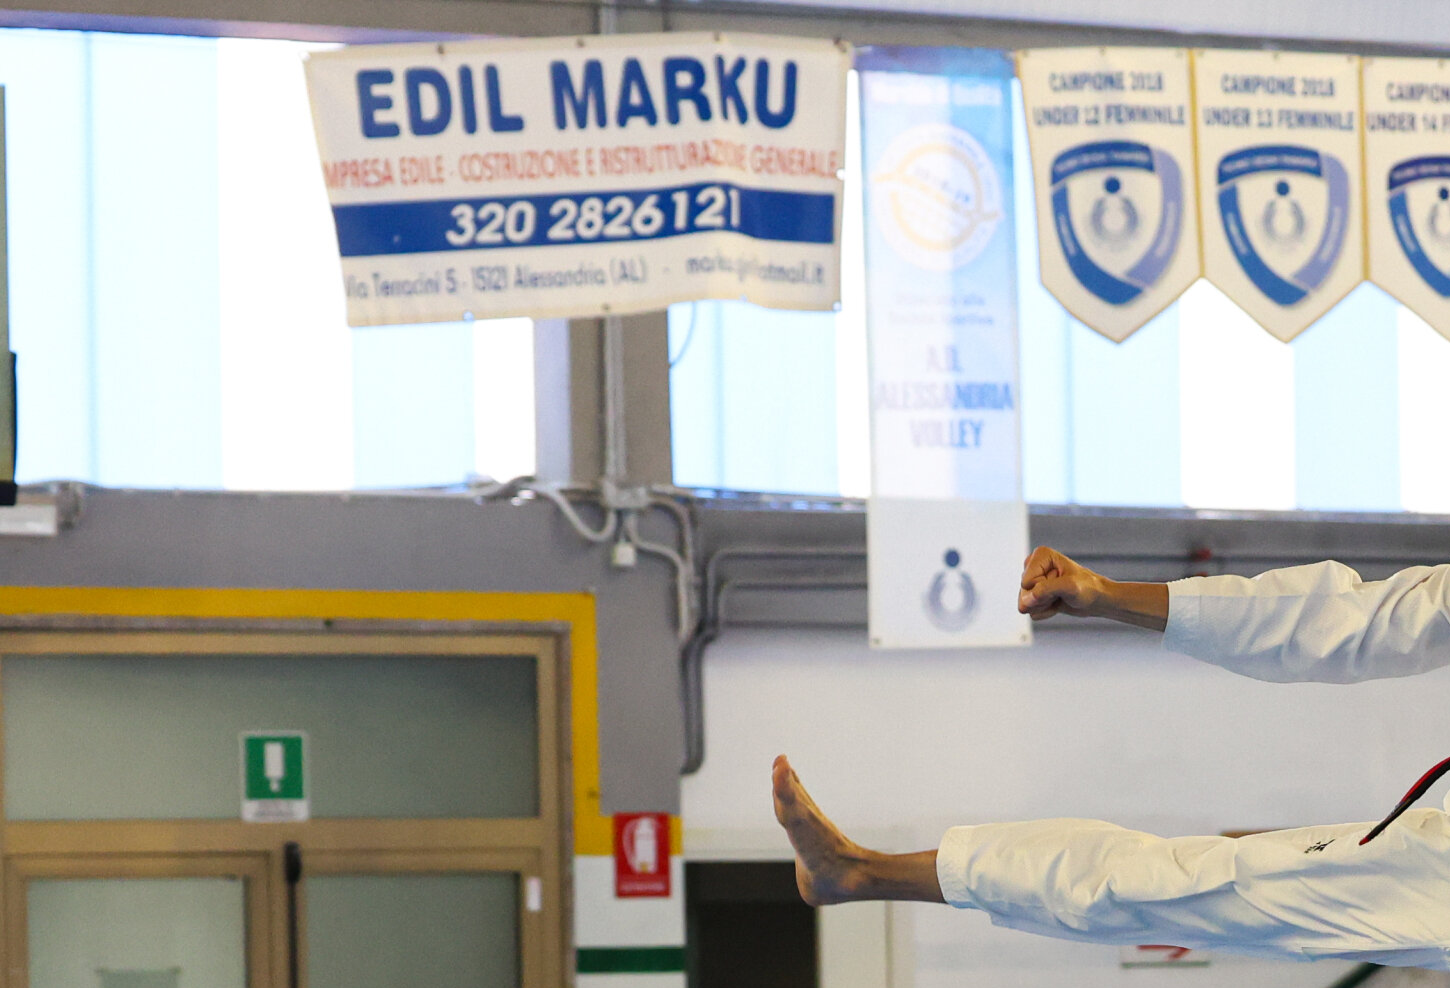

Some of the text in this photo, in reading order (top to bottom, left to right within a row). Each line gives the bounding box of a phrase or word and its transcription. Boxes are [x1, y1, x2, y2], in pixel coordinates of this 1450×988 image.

[1049, 71, 1125, 92] CAMPIONE
[1220, 74, 1296, 96] CAMPIONE
[356, 55, 798, 138] EDIL MARKU
[1032, 105, 1080, 126] UNDER
[1105, 103, 1185, 126] FEMMINILE
[1202, 107, 1251, 126] UNDER
[1278, 109, 1354, 131] FEMMINILE
[1366, 112, 1415, 132] UNDER
[399, 154, 446, 185] EDILE
[457, 147, 582, 184] COSTRUZIONE
[585, 147, 597, 178] E
[752, 144, 840, 179] GENERALE
[445, 186, 741, 246] 320 2826121
[372, 270, 442, 298] Terracini
[445, 267, 458, 294] 5
[514, 262, 607, 289] Alessandria
[609, 256, 649, 285] (AL)
[909, 418, 985, 449] VOLLEY
